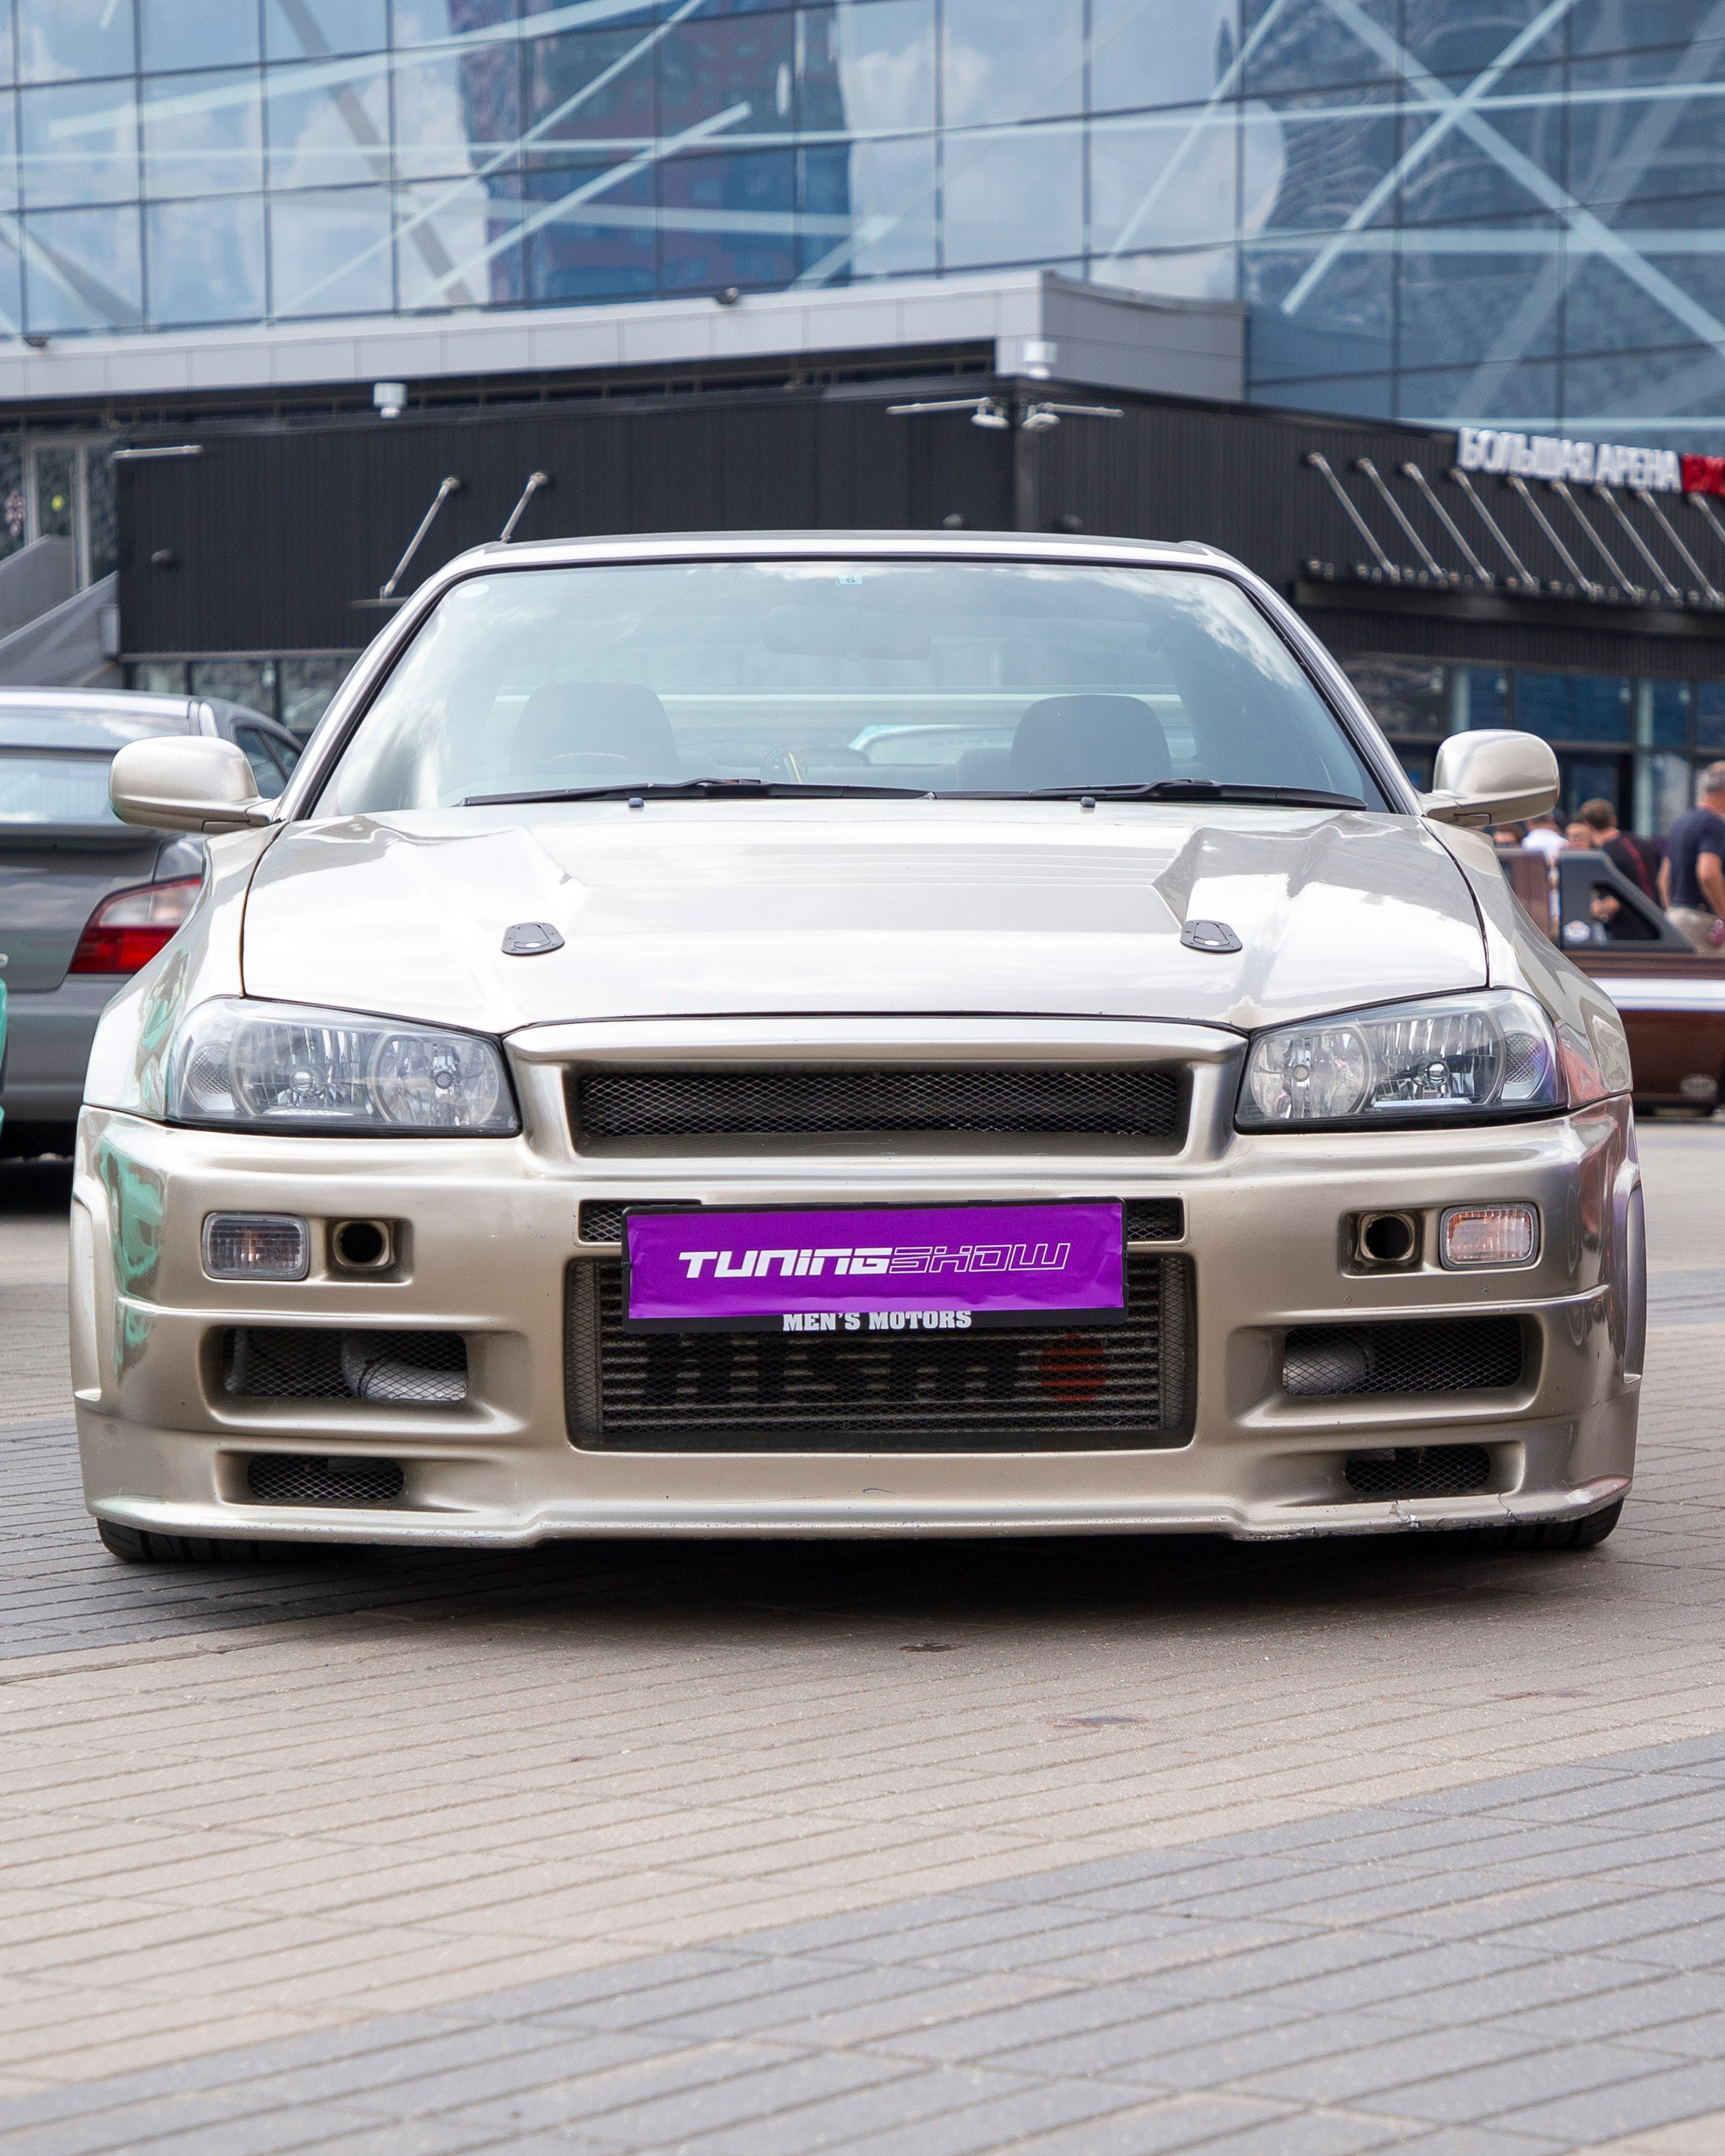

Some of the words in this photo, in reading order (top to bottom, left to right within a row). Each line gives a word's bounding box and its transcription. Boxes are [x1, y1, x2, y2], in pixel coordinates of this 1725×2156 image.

[1457, 427, 1594, 485] БОЛЬШАЯ
[1595, 442, 1682, 493] АРЕНА
[869, 1309, 973, 1330] MOTORS
